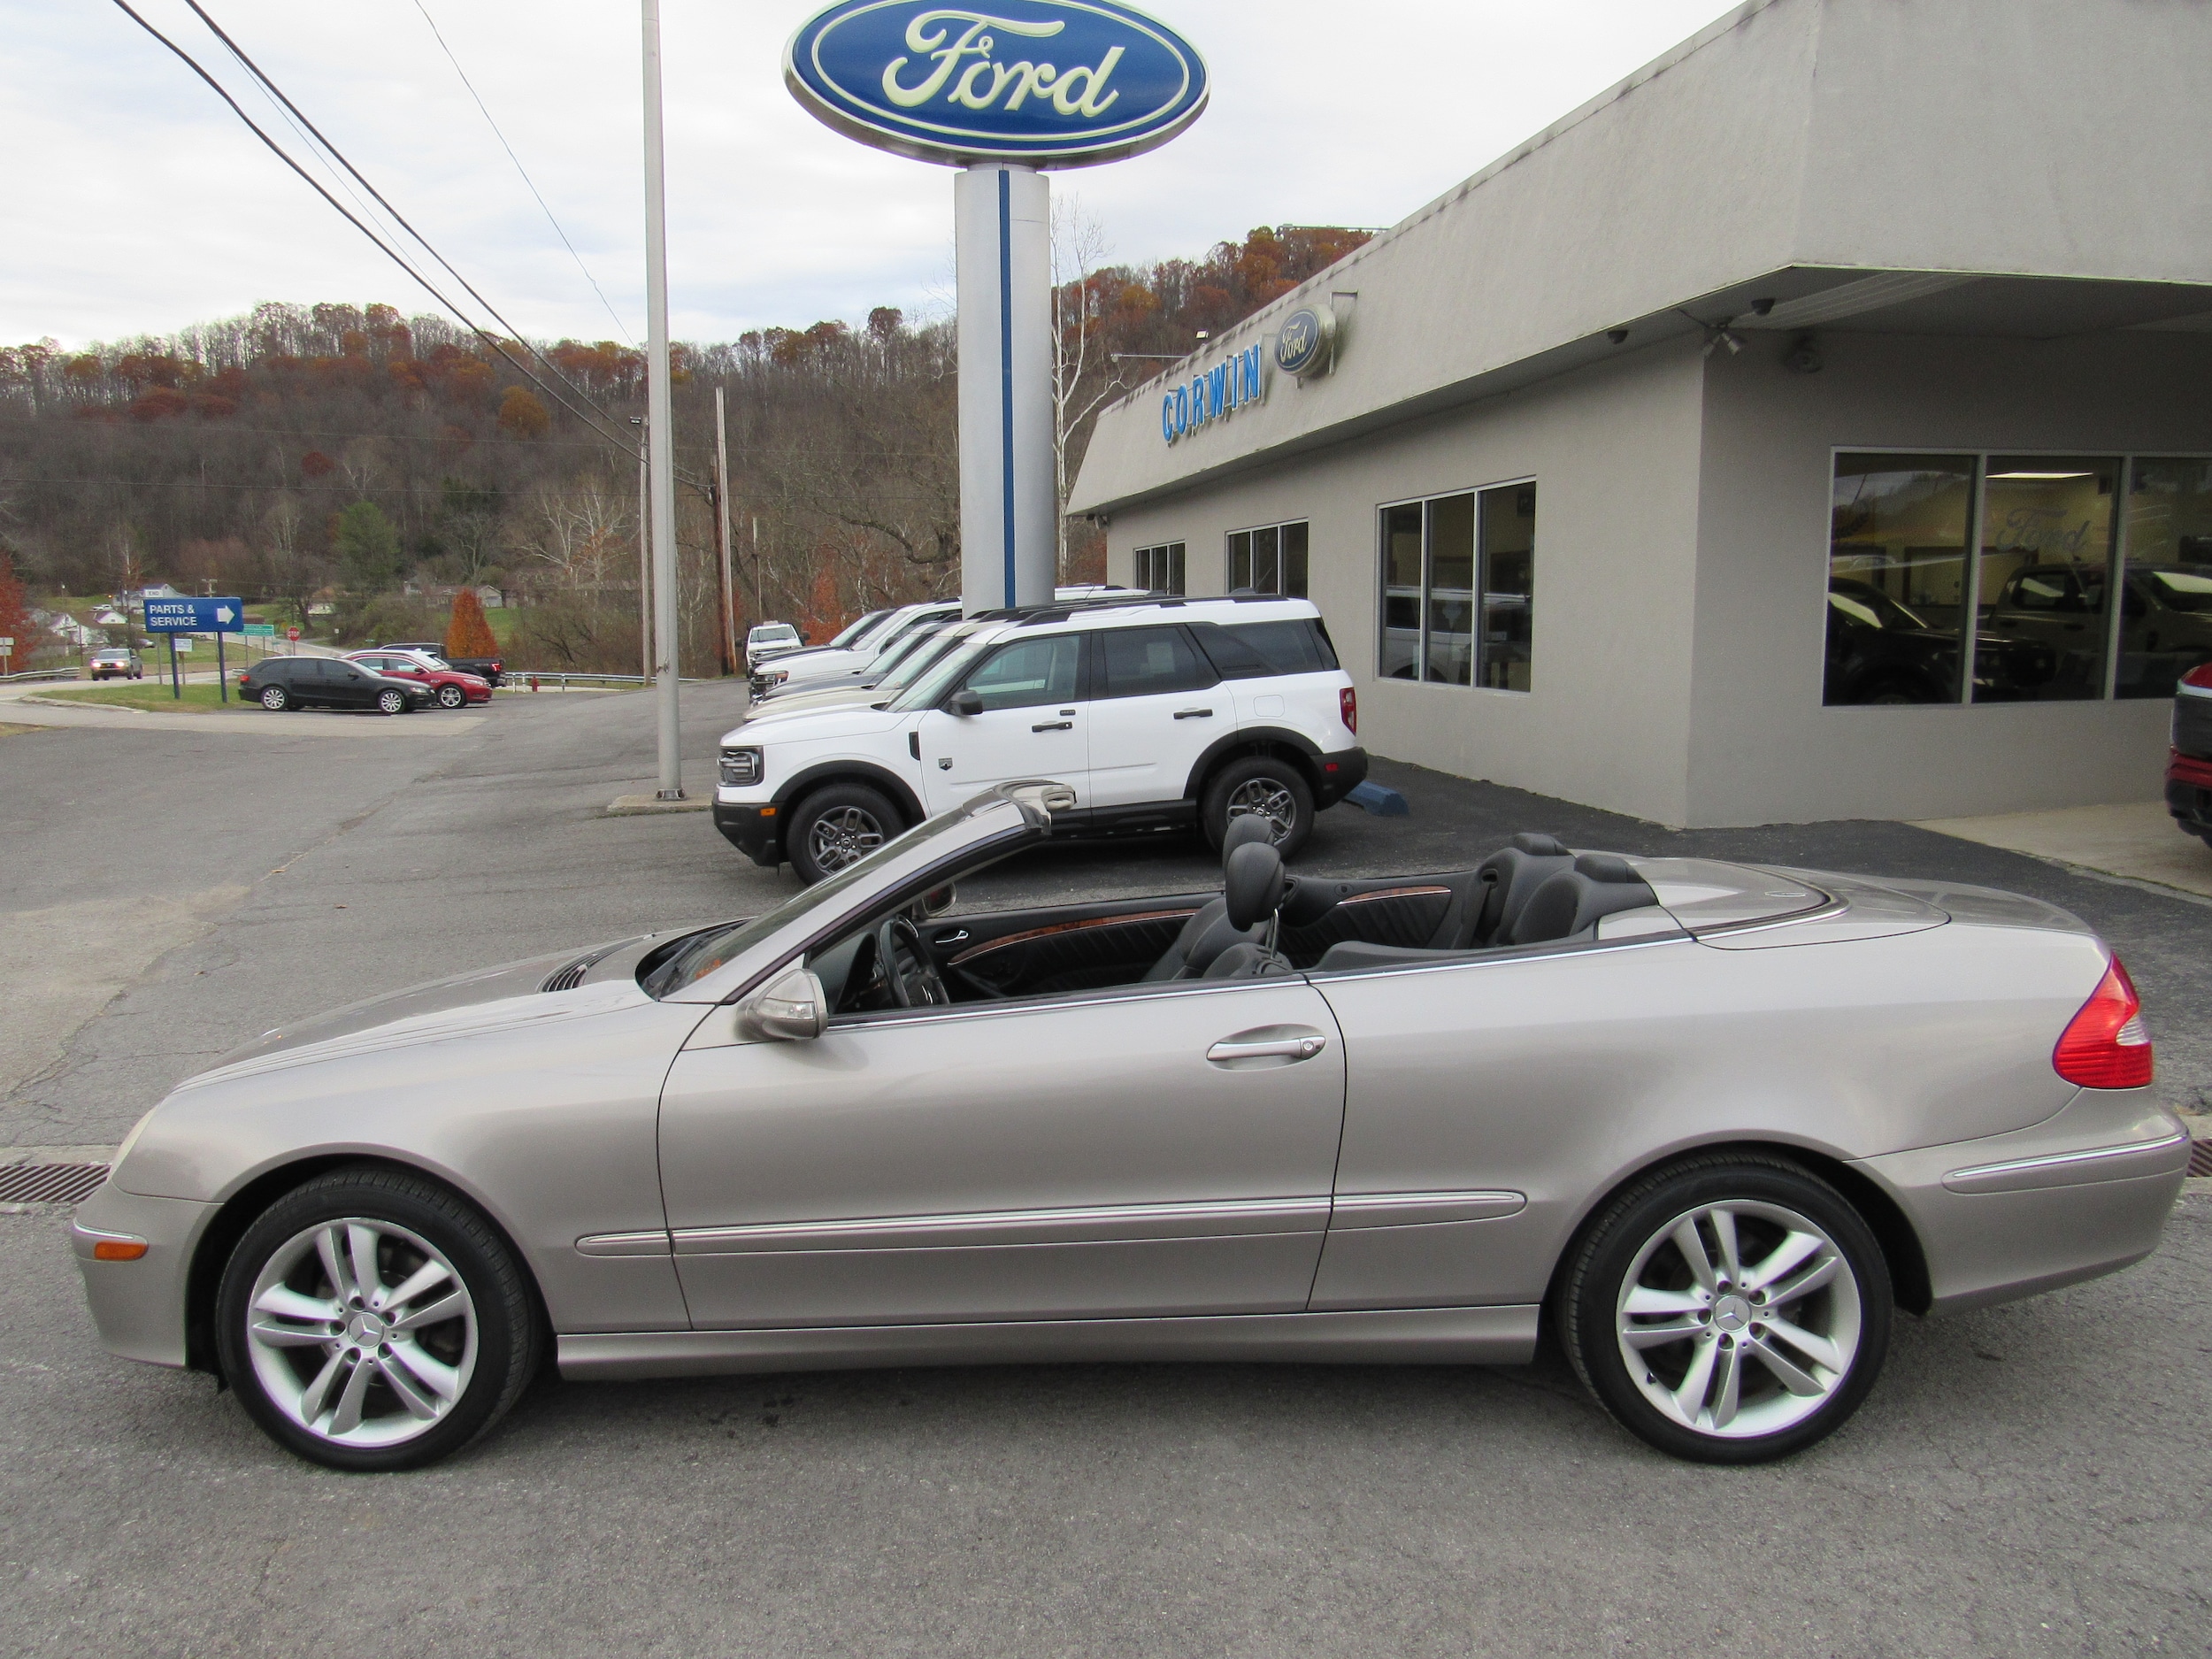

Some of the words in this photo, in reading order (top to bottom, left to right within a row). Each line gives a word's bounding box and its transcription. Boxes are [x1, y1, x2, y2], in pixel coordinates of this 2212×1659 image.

[881, 10, 1125, 118] Ford
[1280, 321, 1308, 363] Ford
[1162, 343, 1261, 442] CORWIN
[1995, 508, 2091, 551] Ford
[150, 604, 185, 615] PARTS
[187, 604, 196, 615] &
[150, 616, 197, 626] SERVICE
